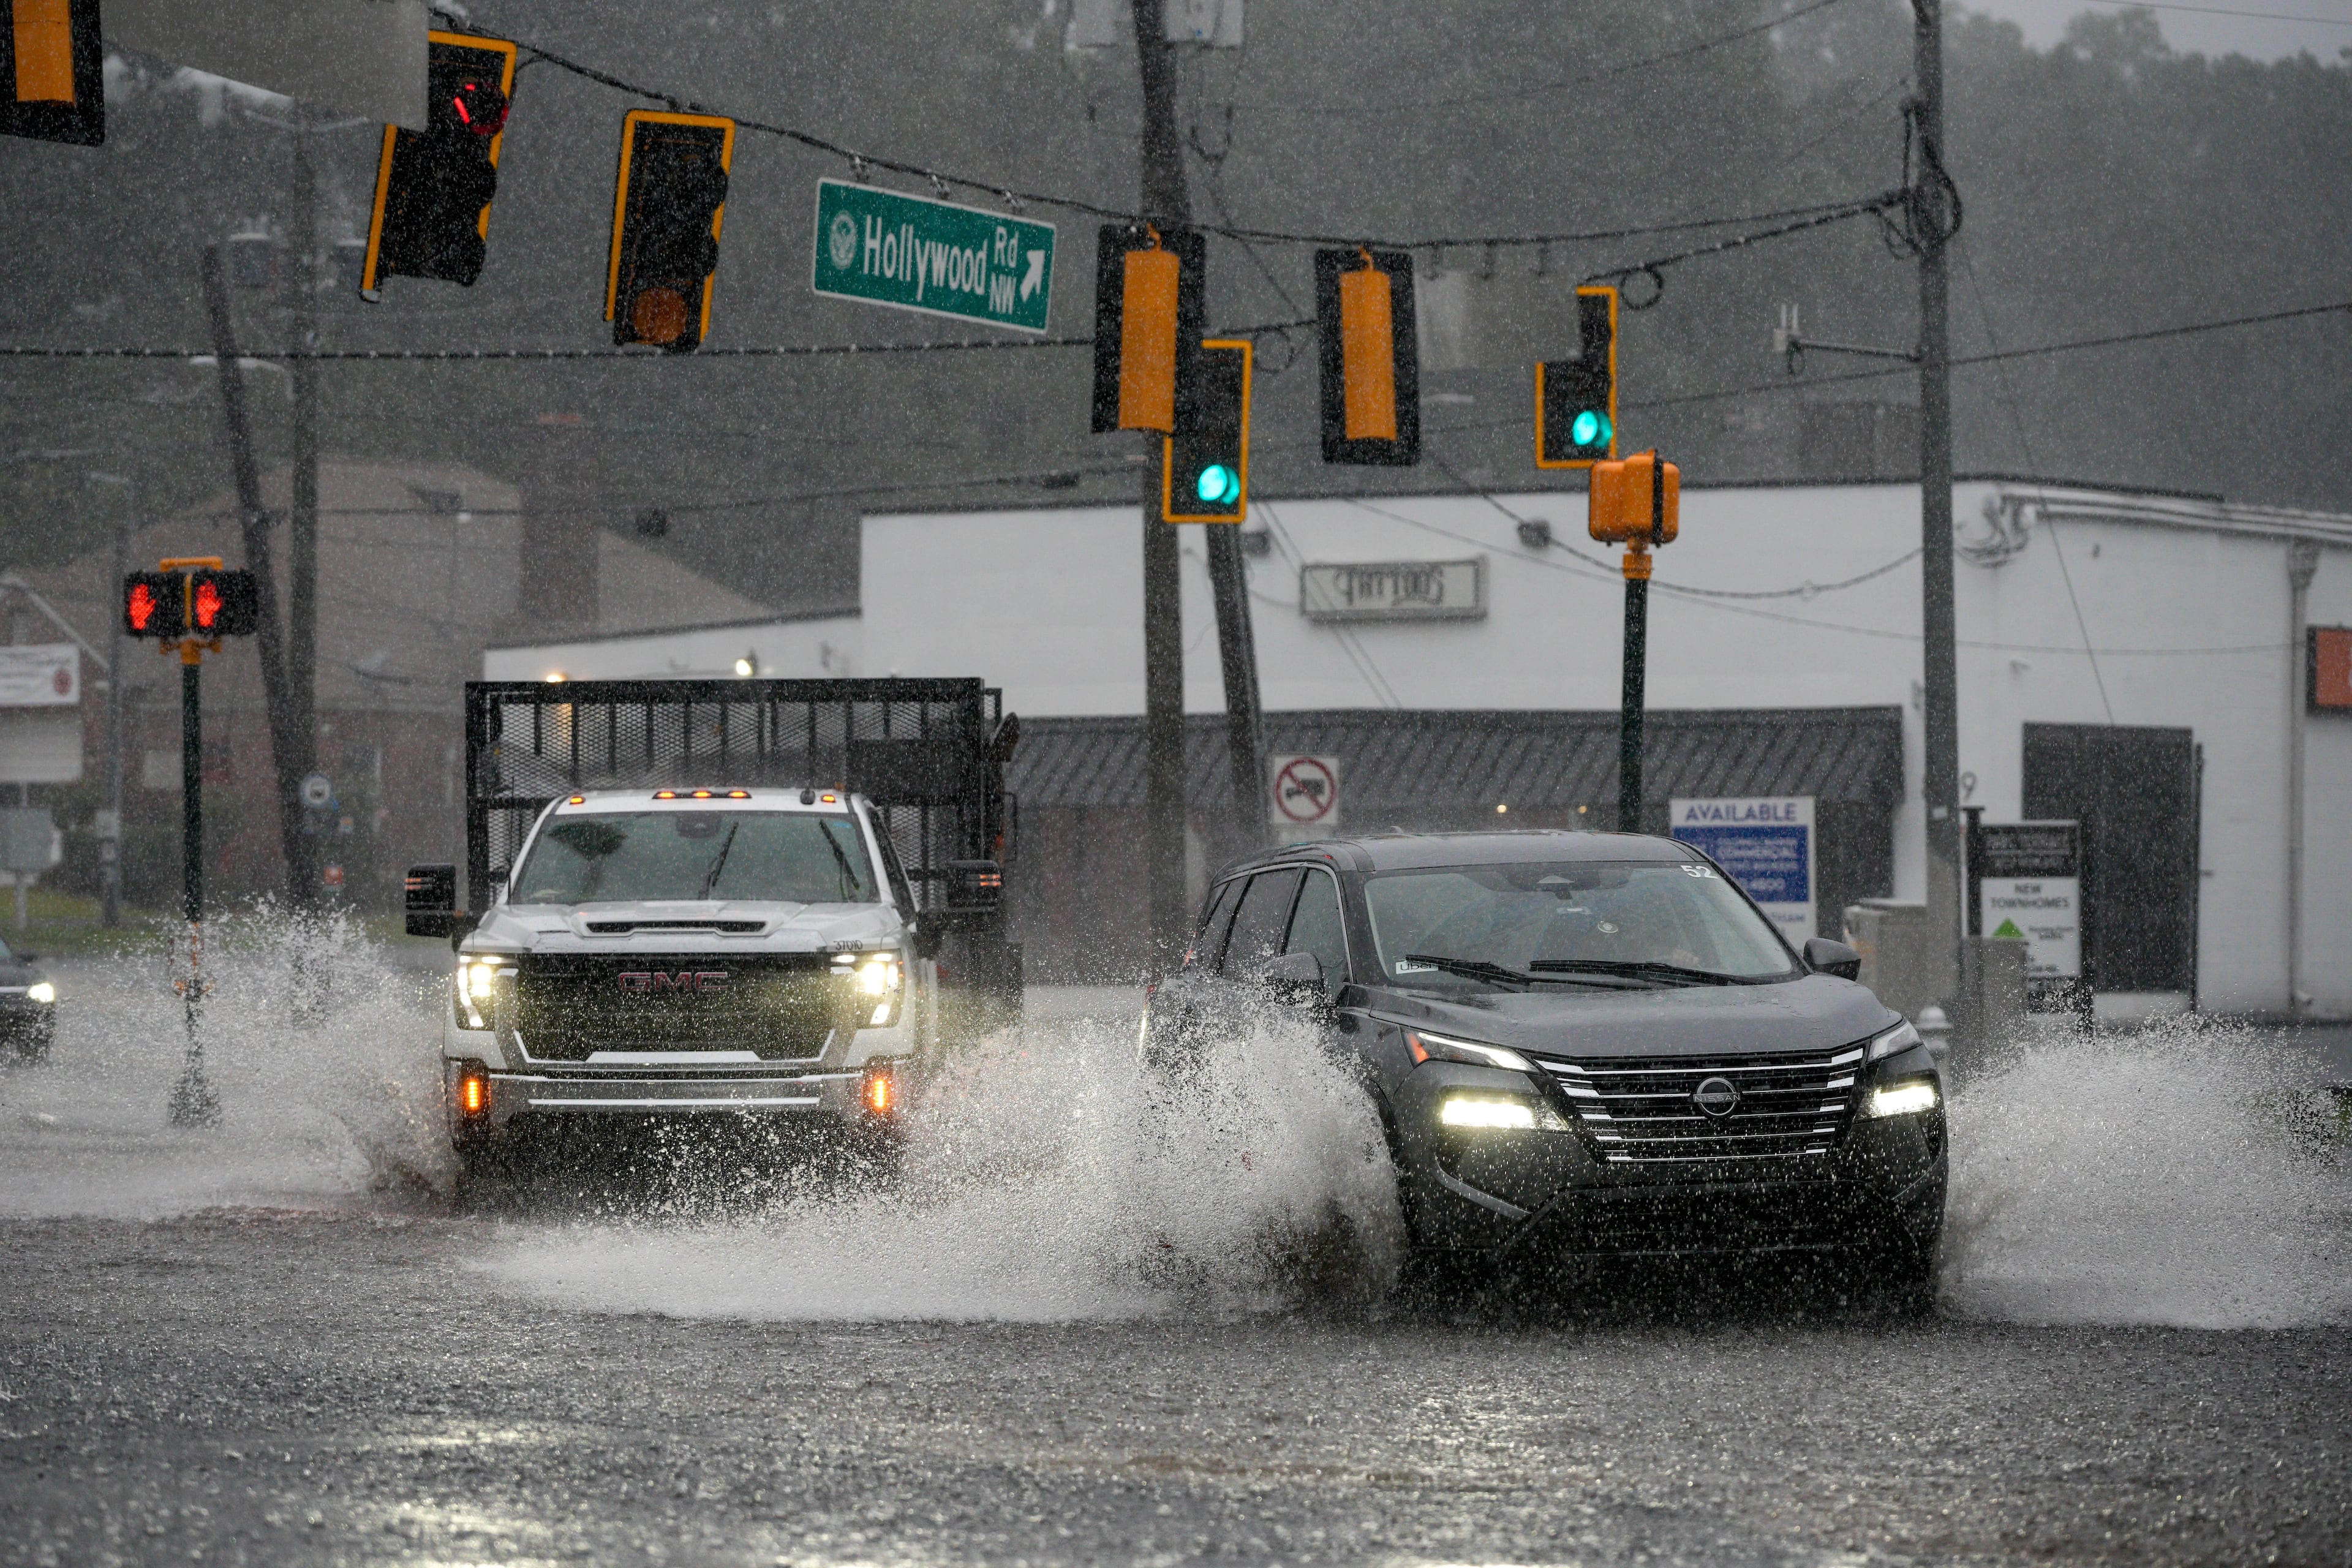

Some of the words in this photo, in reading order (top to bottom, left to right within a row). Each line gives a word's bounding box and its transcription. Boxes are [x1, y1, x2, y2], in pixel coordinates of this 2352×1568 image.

[993, 225, 1019, 268] Rd
[863, 214, 987, 302] Hollywood
[989, 272, 1017, 315] NW
[1686, 803, 1797, 821] AVAILABLE
[1680, 865, 1719, 880] 52
[2014, 883, 2041, 894] NEW
[1990, 897, 2070, 909] TOWNHOMES
[833, 940, 863, 951] 37010
[618, 971, 728, 991] GMC
